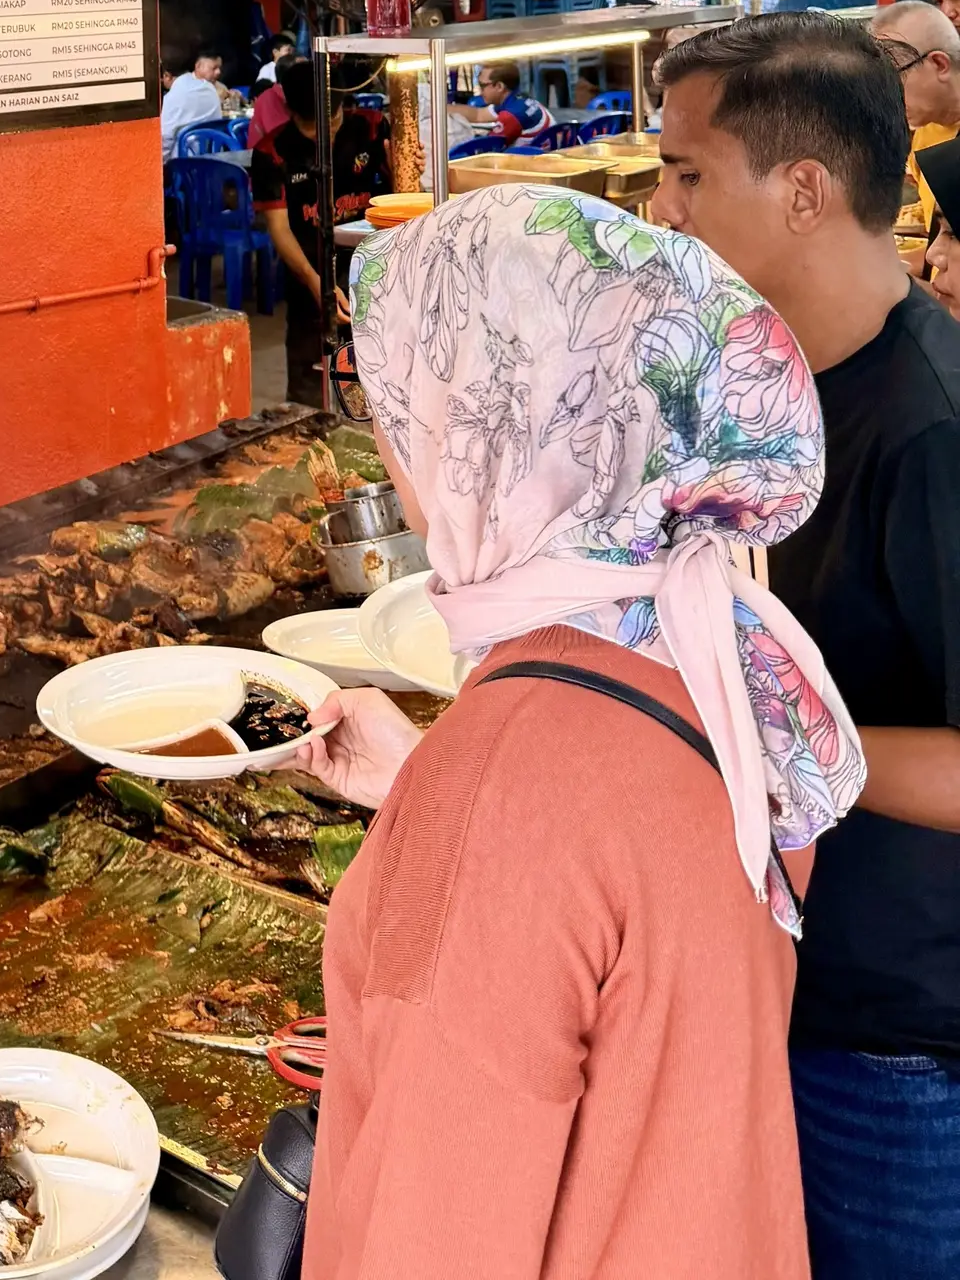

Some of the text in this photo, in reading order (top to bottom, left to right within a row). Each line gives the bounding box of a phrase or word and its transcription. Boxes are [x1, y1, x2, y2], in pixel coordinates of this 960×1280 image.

[51, 21, 73, 31] RM20
[75, 19, 115, 29] SEHINGGA
[117, 18, 138, 26] RM40
[52, 45, 72, 55] RM15
[73, 44, 114, 53] SEHINGGA
[115, 41, 136, 50] RM45
[52, 69, 72, 79] RM15
[74, 64, 128, 79] (SEMANGKUK)
[9, 96, 40, 107] HARIAN
[42, 95, 60, 104] DAN
[62, 93, 79, 102] SAIZ
